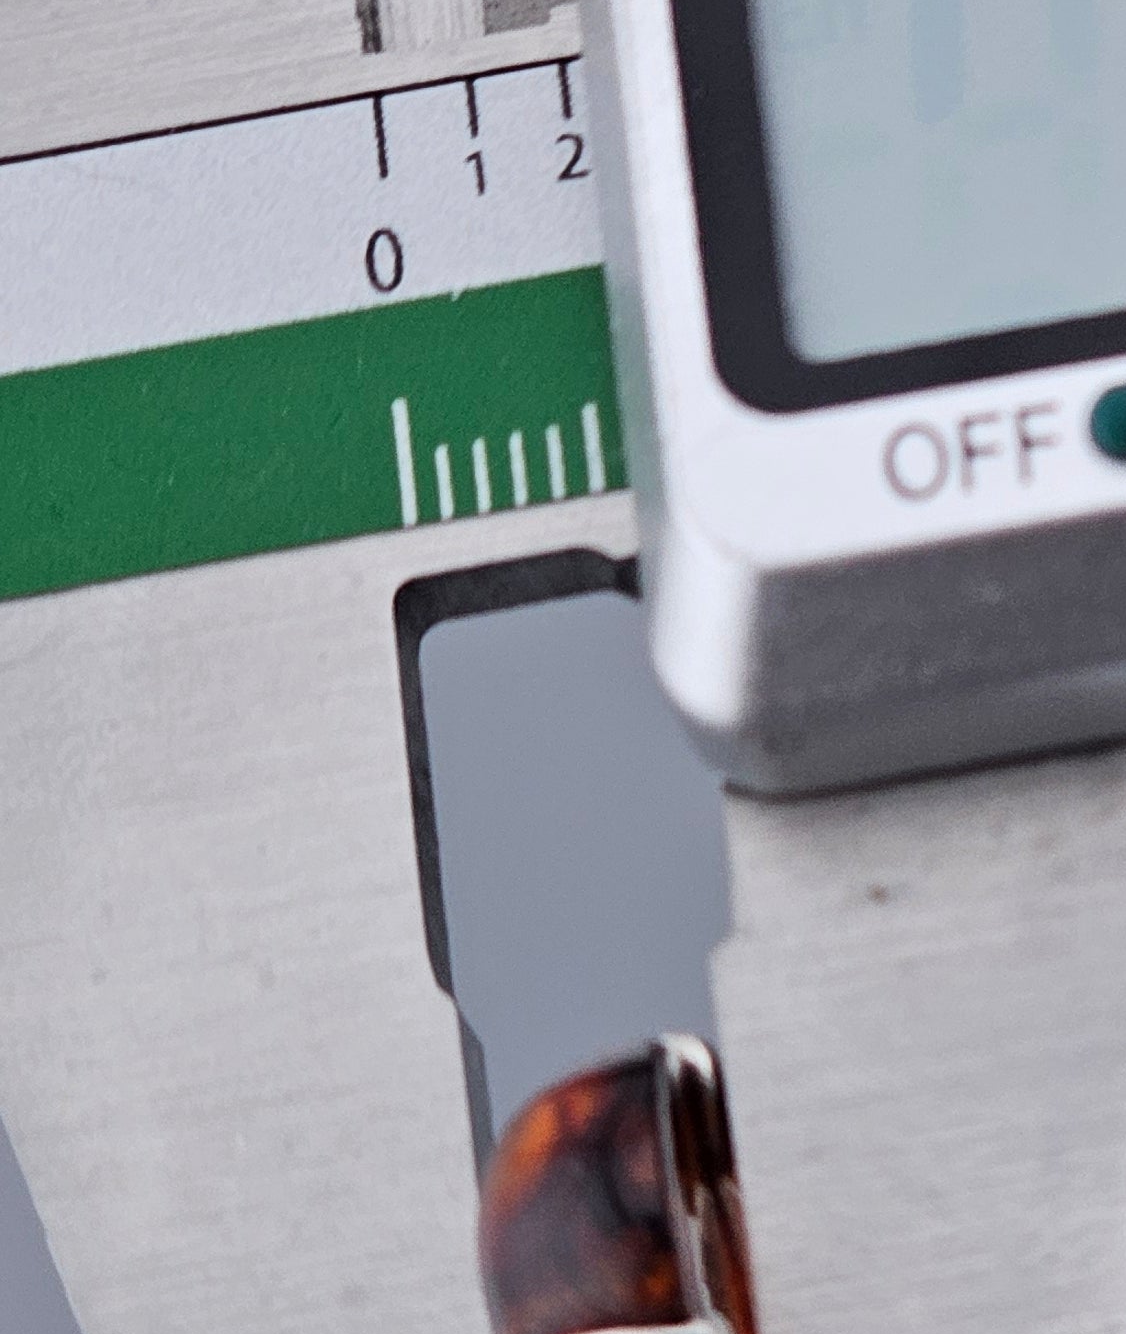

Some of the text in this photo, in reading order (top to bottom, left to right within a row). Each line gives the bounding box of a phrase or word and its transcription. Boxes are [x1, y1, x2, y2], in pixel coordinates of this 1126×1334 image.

[464, 132, 592, 195] 1 2
[365, 227, 404, 293] 0
[882, 400, 1061, 501] OFF
